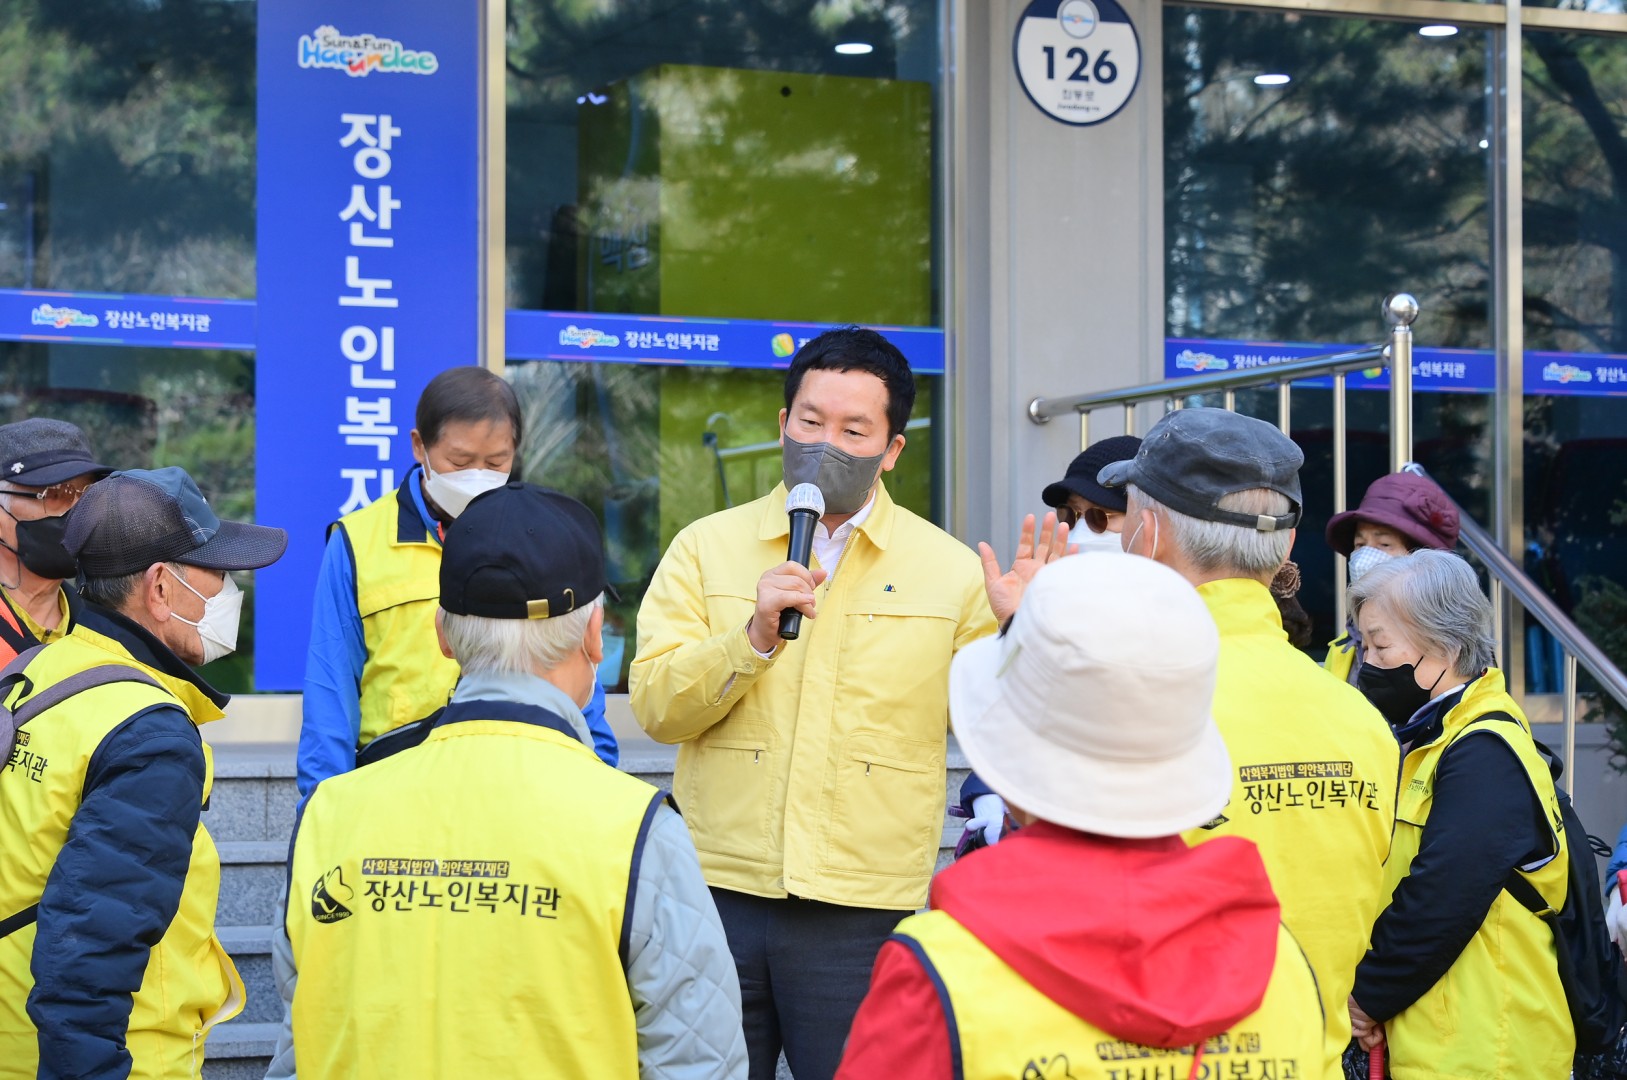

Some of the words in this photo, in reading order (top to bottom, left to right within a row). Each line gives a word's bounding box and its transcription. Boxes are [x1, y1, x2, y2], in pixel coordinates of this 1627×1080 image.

[323, 35, 392, 50] Sun&Fun
[302, 39, 434, 72] Haeundae
[1043, 46, 1118, 84] 126
[104, 310, 211, 332] 장산노인복지관
[624, 331, 720, 351] 장산노인복지관
[1240, 764, 1295, 781] 사회복지법인
[1297, 762, 1353, 778] 의안복지재단
[1243, 779, 1380, 815] 장산노인복지관
[362, 859, 435, 876] 사회복지법인
[439, 861, 509, 878] 의안복지재단
[363, 879, 562, 920] 장산노인복지관
